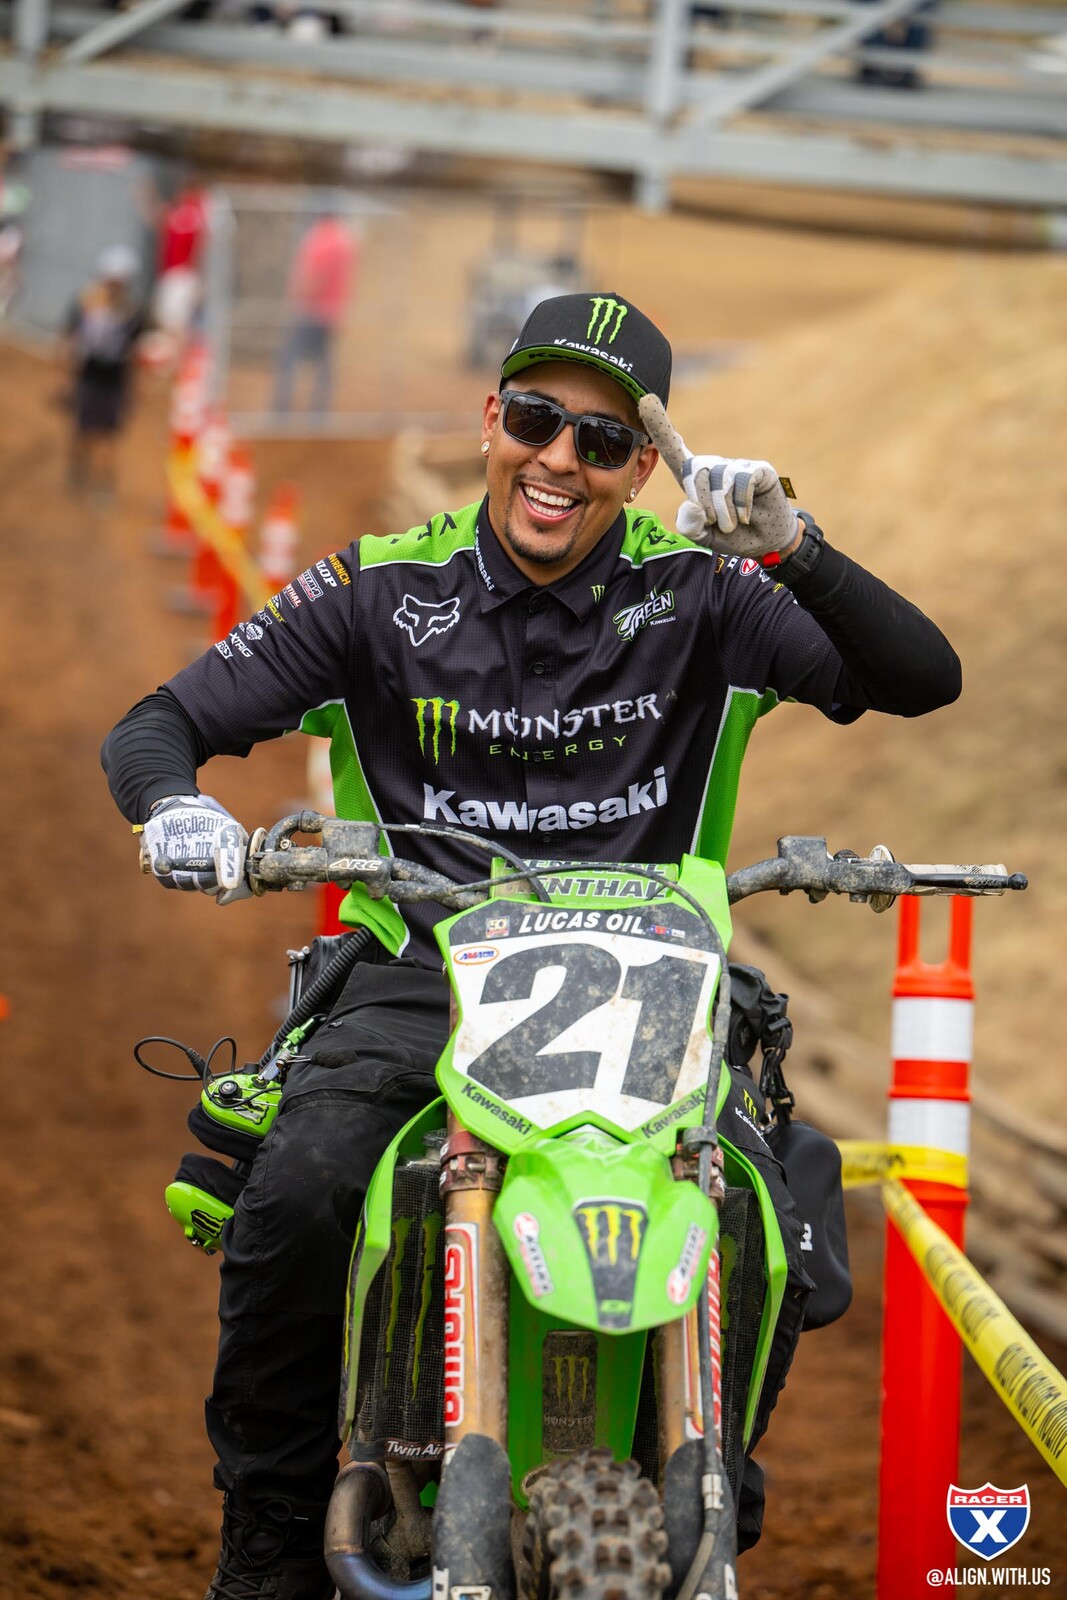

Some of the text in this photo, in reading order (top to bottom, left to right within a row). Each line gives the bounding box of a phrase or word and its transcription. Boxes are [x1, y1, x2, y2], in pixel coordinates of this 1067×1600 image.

[553, 338, 633, 373] Kawasaki
[229, 632, 254, 658] XTRIG
[468, 692, 663, 741] MONSTER
[489, 735, 627, 761] ENERGY
[423, 765, 668, 833] Kawasaki
[329, 858, 383, 871] ARC
[518, 911, 601, 935] LUCAS
[606, 914, 645, 935] OIL
[467, 943, 708, 1107] 21
[461, 1082, 533, 1137] Kawasaki
[641, 1089, 707, 1139] Kawasaki
[387, 1440, 421, 1456] Twin
[421, 1443, 444, 1455] Air
